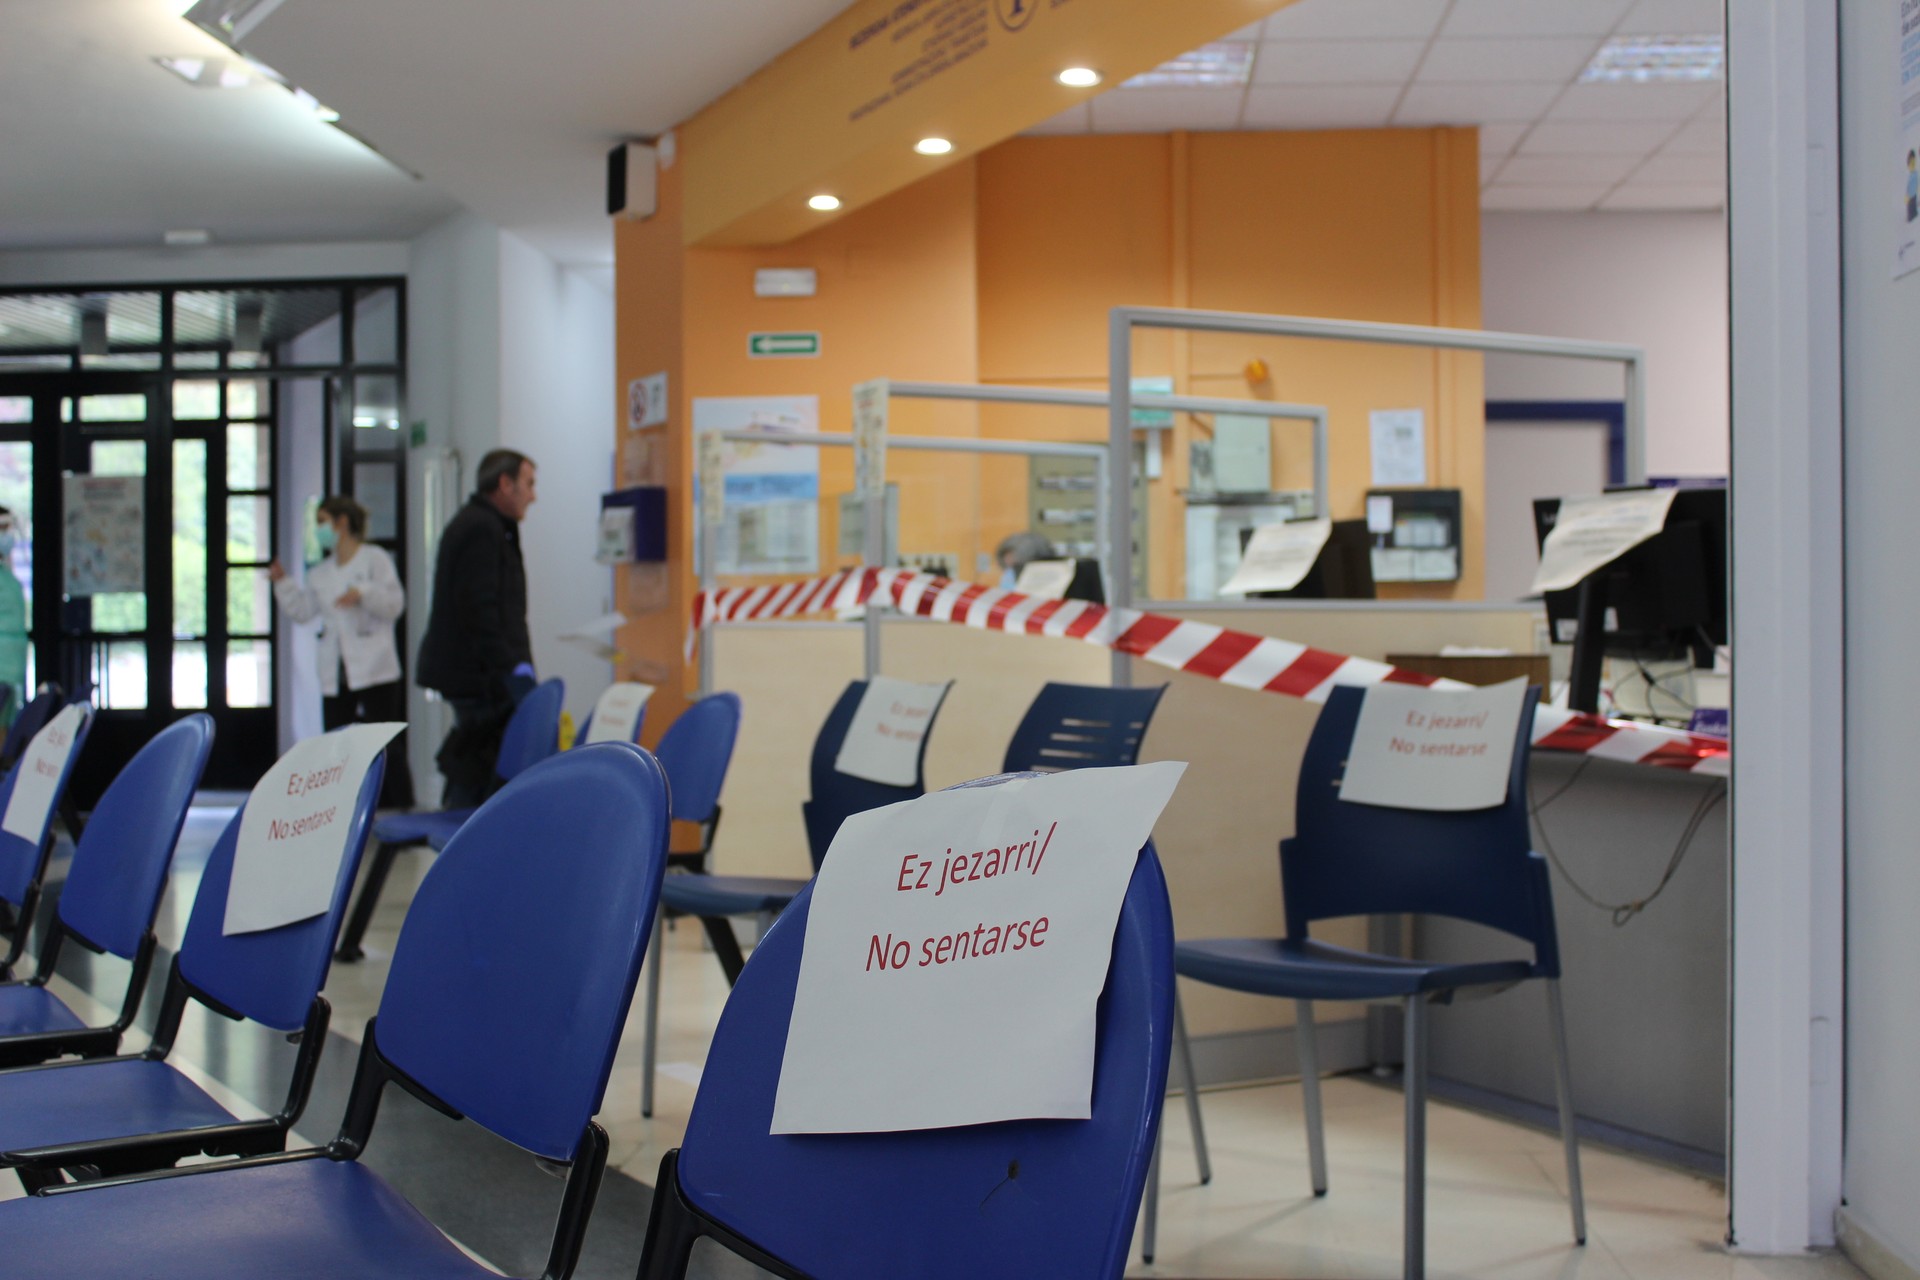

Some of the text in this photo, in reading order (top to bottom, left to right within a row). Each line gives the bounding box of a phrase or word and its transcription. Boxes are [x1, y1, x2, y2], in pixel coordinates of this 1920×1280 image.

[1406, 709, 1426, 728] Ez
[1389, 737, 1489, 757] No sentarse
[287, 772, 304, 796] Ez
[267, 805, 338, 841] No sentarse
[897, 821, 1058, 897] Ez jezarri/
[865, 916, 1049, 972] No sentarse
